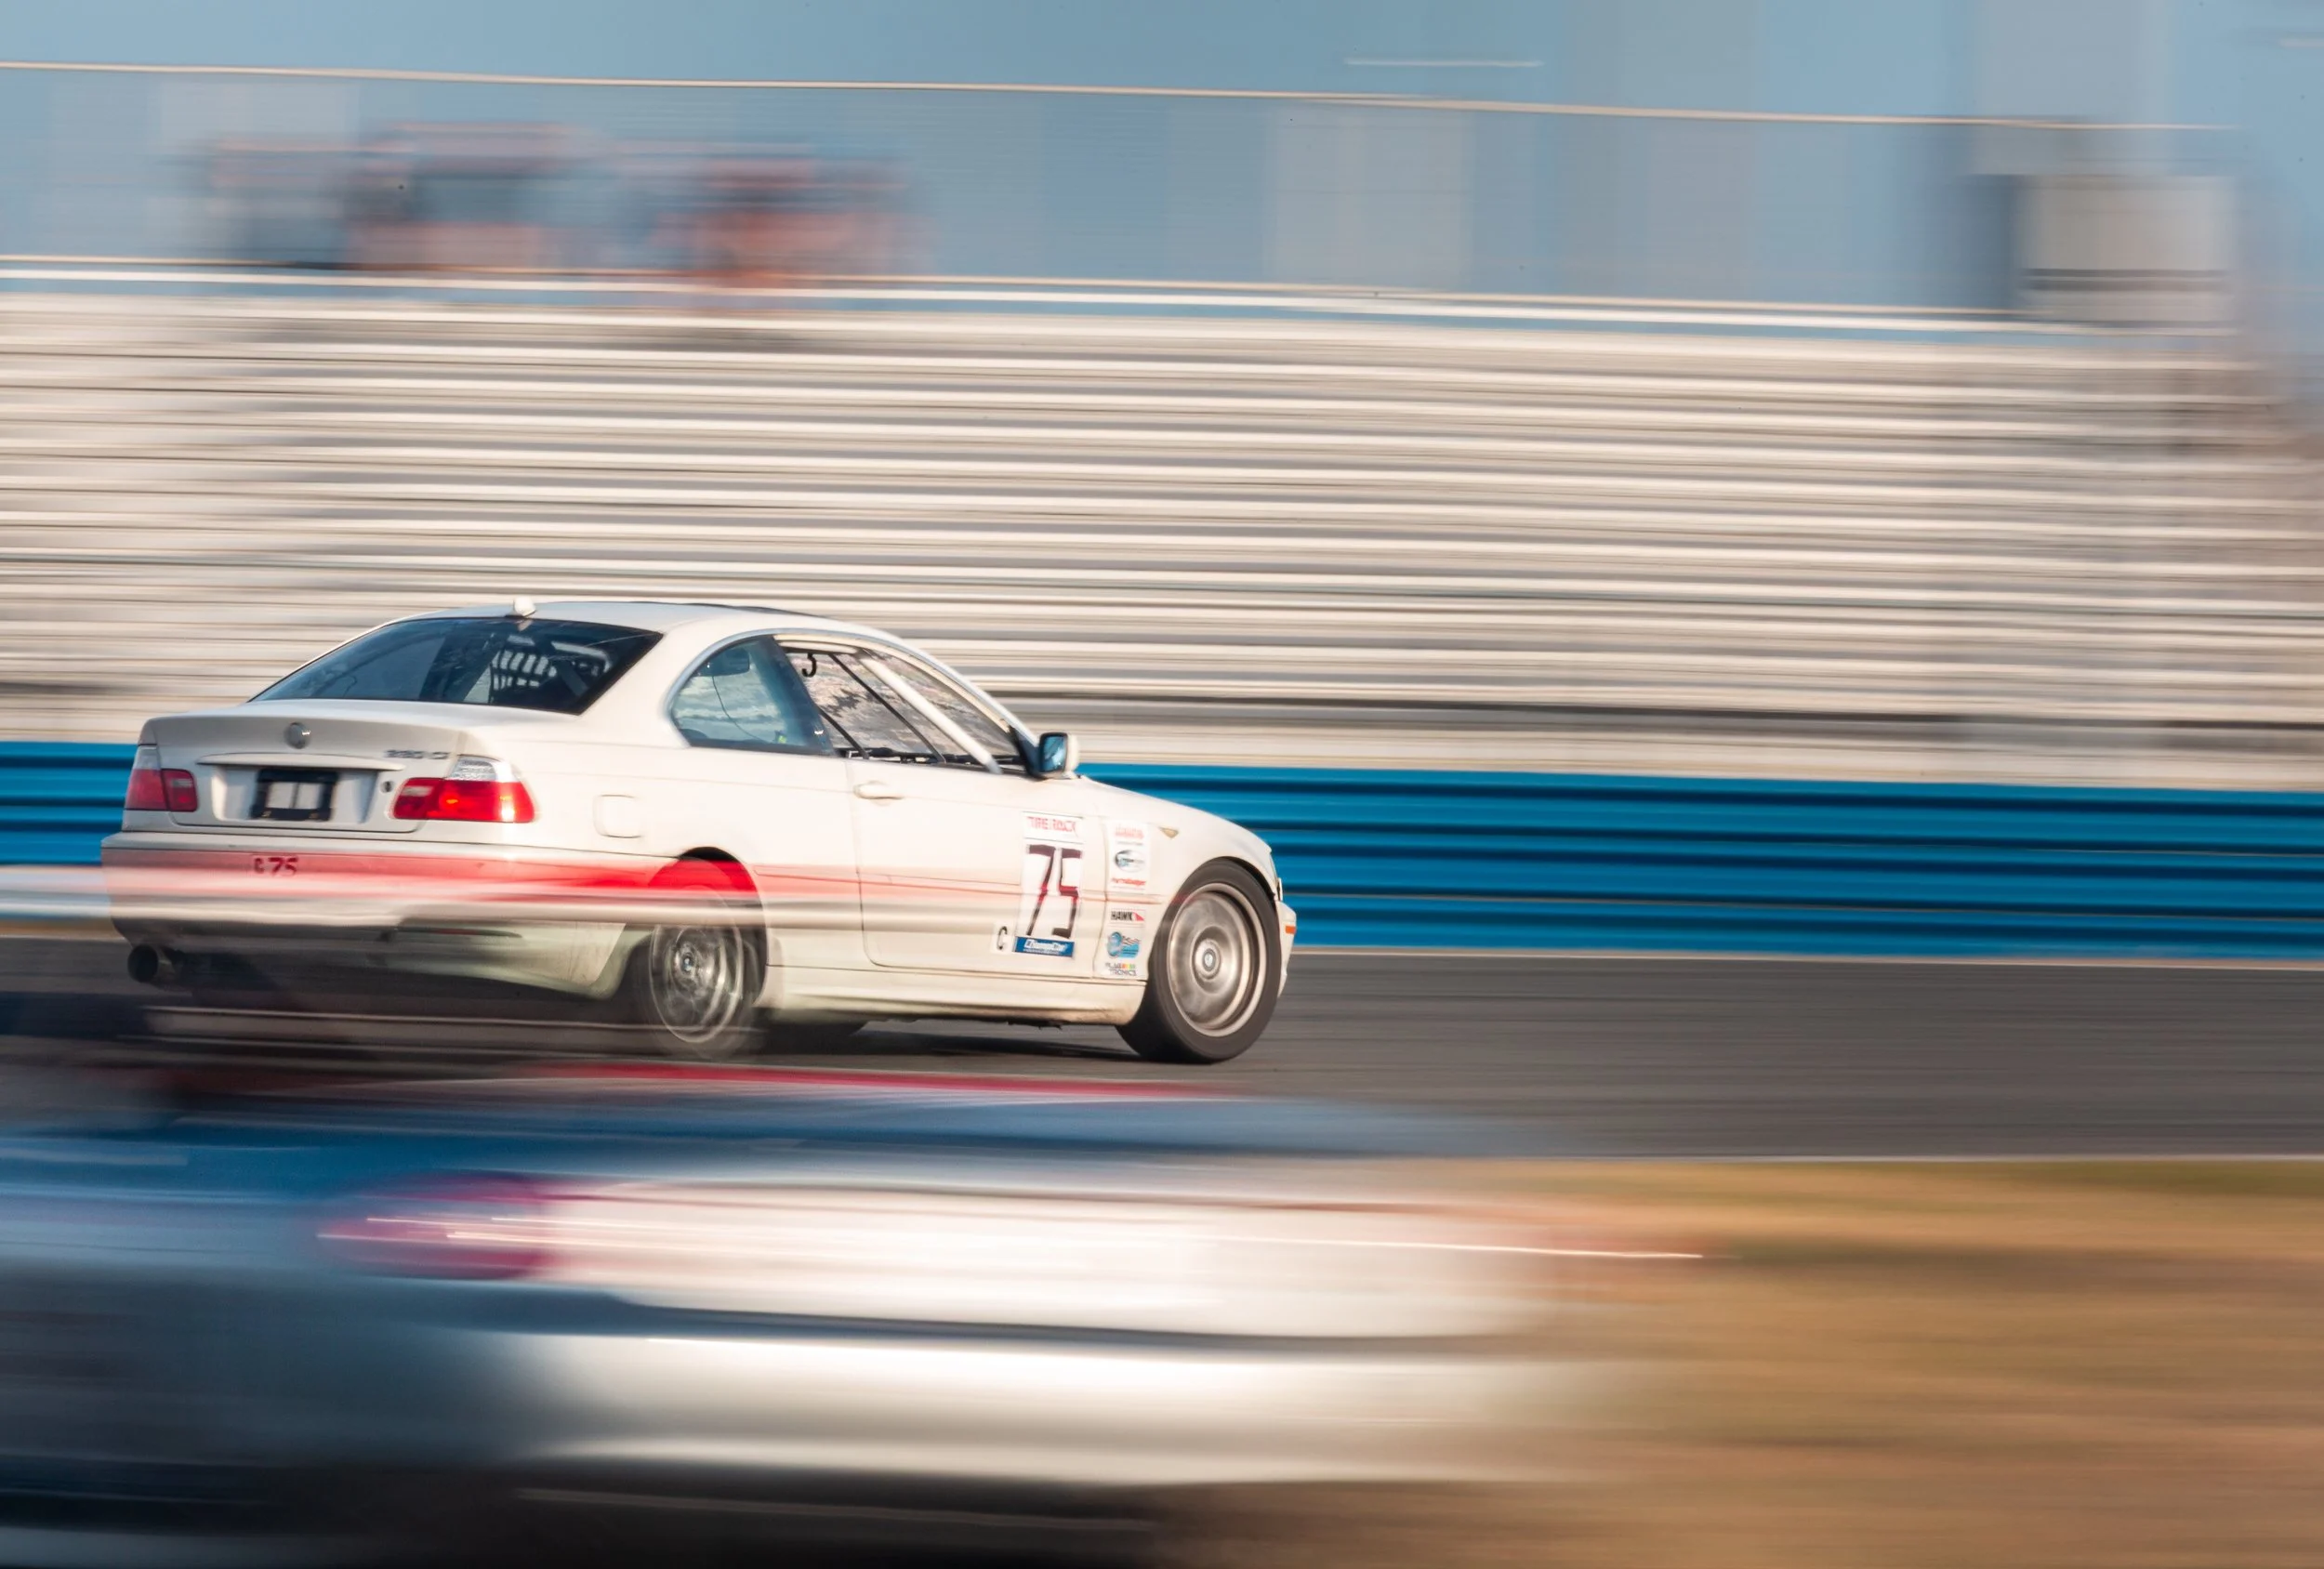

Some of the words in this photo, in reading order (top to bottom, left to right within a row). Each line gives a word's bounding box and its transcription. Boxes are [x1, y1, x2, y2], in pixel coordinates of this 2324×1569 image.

[268, 857, 298, 876] 75
[1026, 844, 1082, 939] 75
[1111, 911, 1133, 921] HAWK
